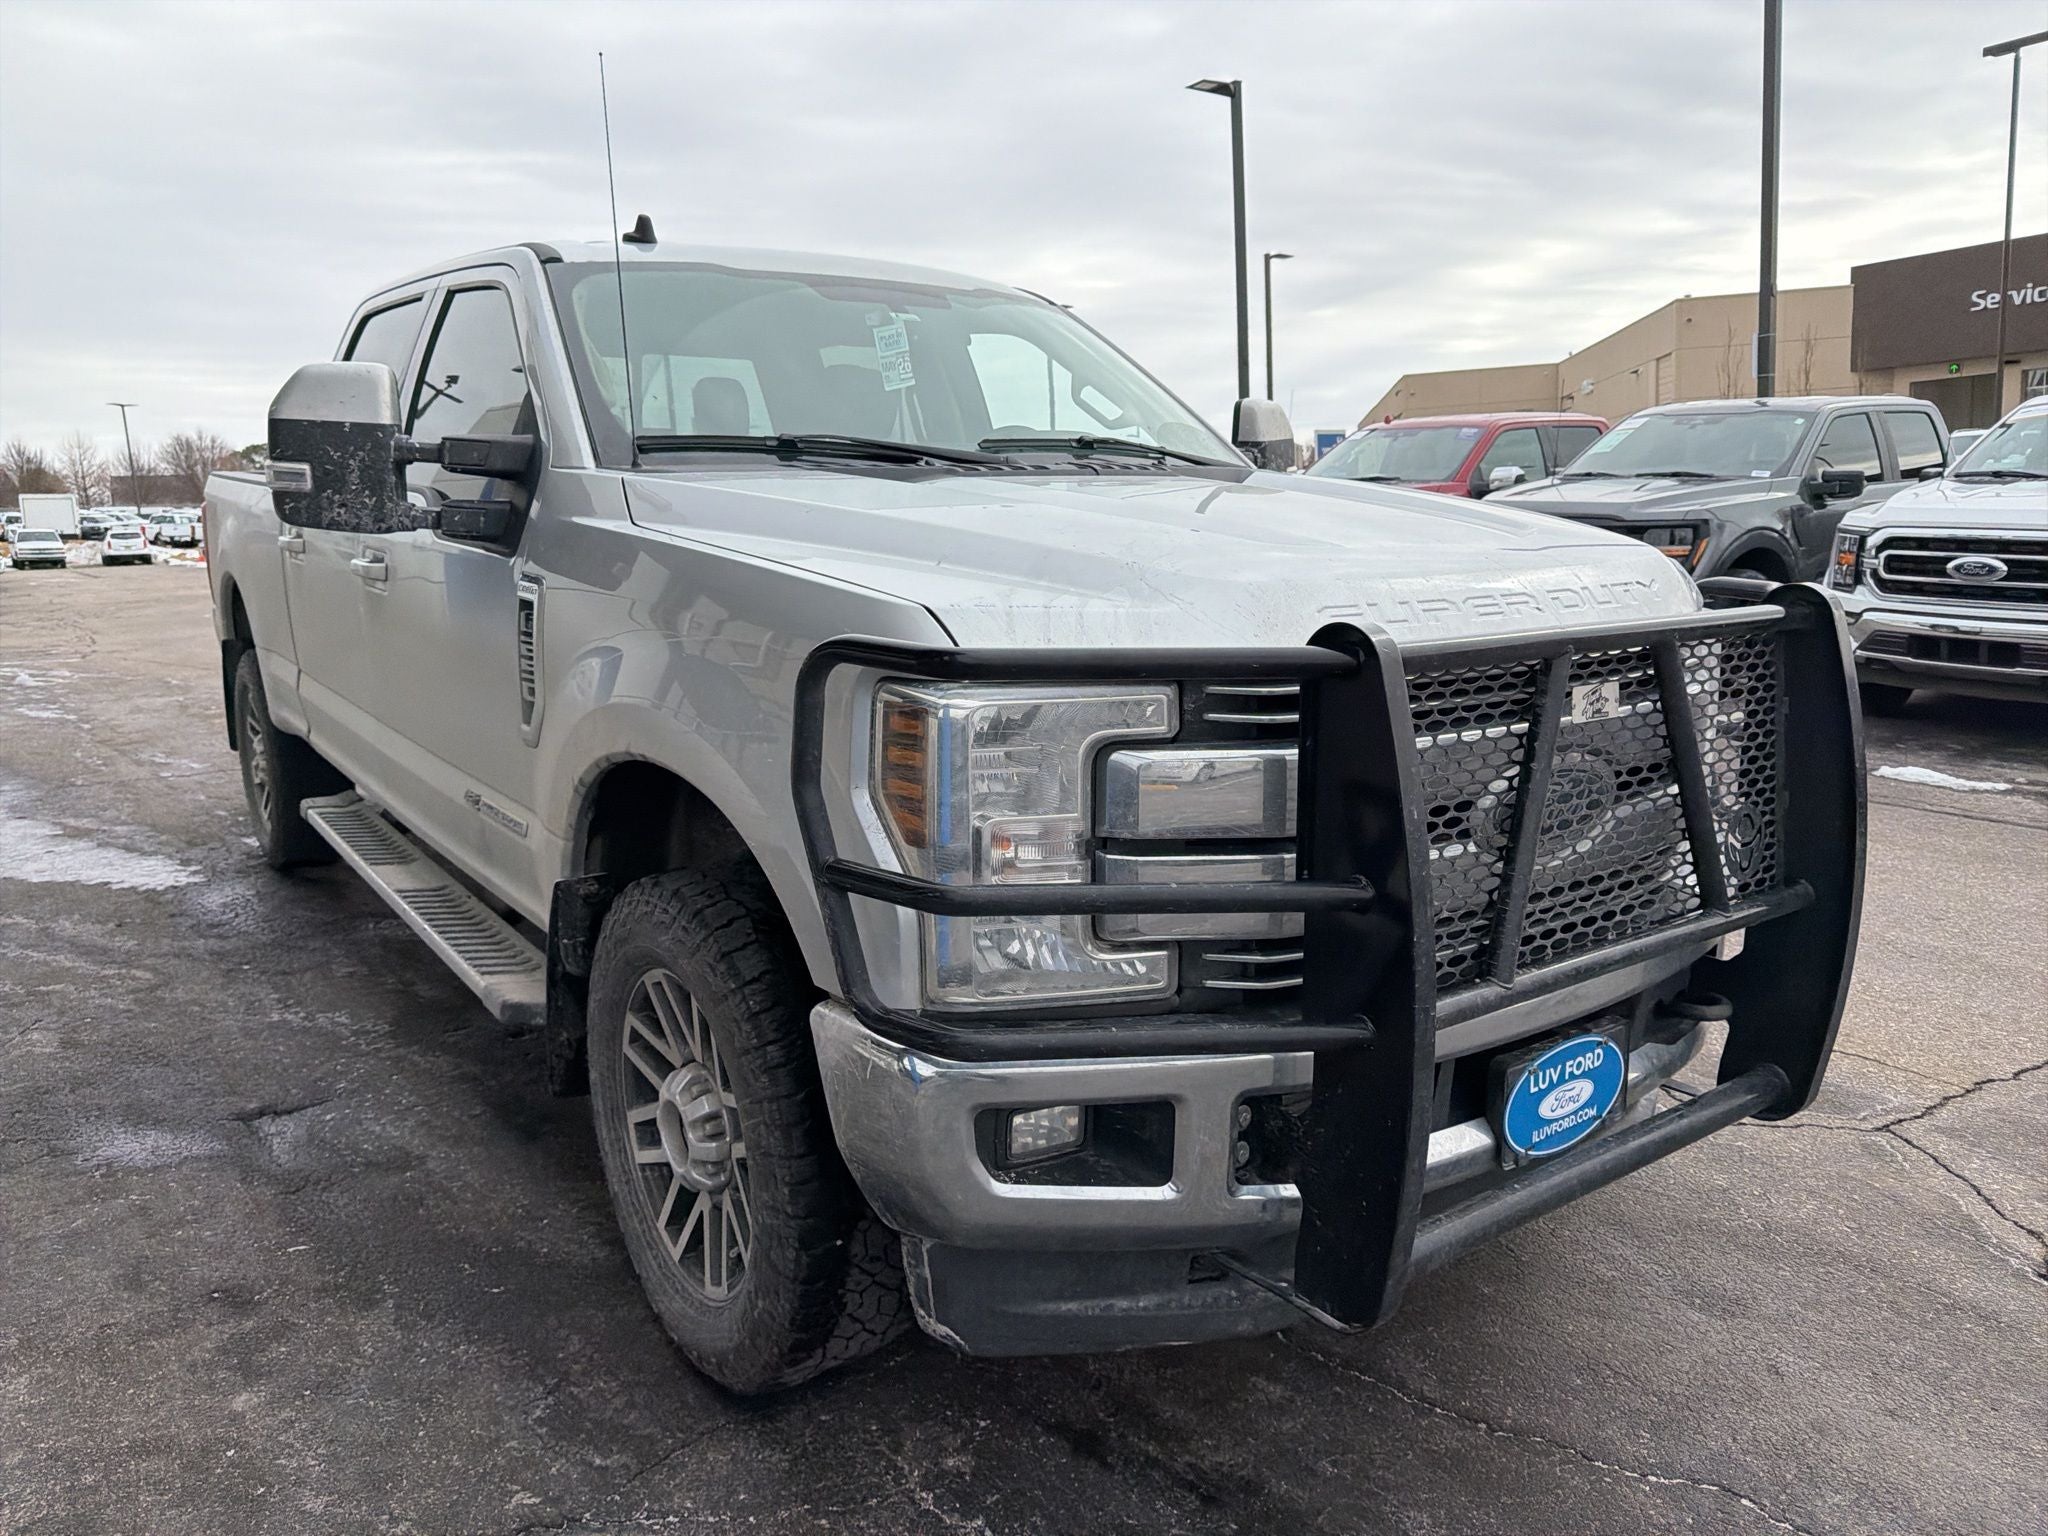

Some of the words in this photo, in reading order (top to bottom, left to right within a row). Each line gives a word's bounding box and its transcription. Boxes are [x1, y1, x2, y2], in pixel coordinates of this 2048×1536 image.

[1960, 562, 1989, 575] Ford
[1316, 591, 1545, 627] SUPER
[1546, 577, 1662, 613] DUTY
[1529, 1064, 1561, 1094] LUV
[1564, 1048, 1604, 1080] FORD
[1550, 1085, 1584, 1113] Ford
[1532, 1105, 1598, 1143] ILUVFORD.COM
